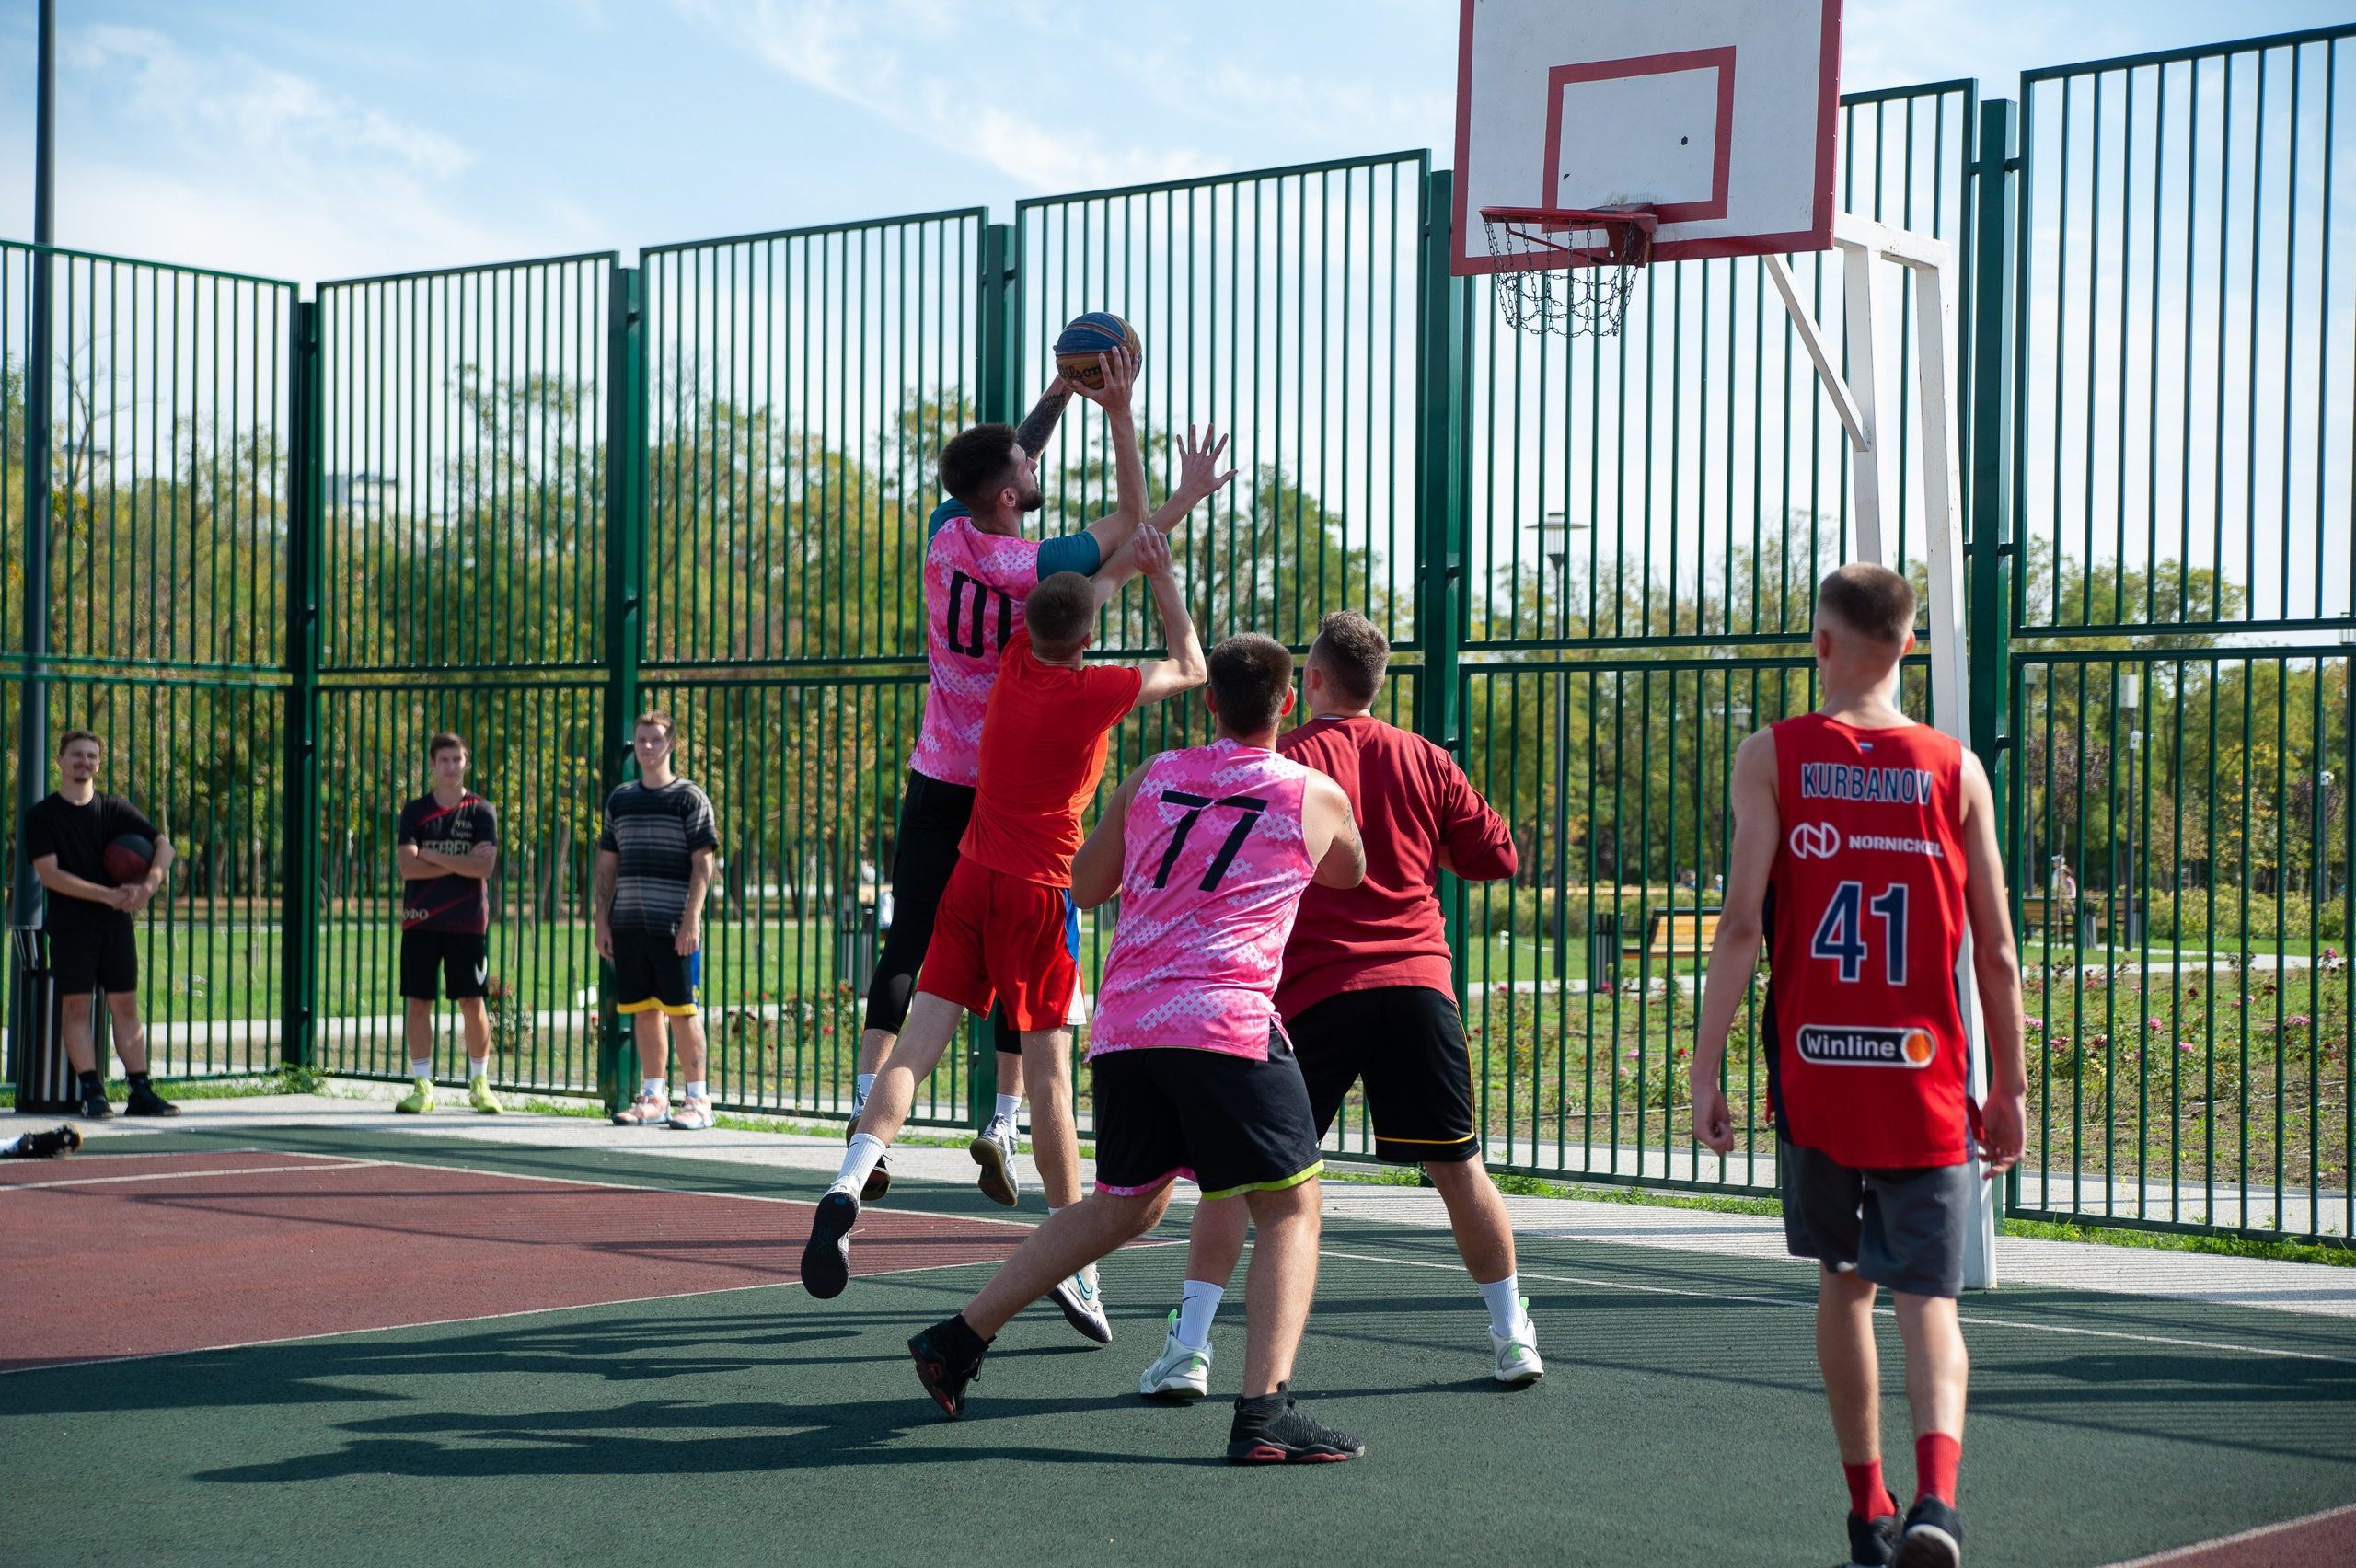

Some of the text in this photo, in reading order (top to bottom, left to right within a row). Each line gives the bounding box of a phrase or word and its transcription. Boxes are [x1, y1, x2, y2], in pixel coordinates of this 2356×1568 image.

[1801, 763, 1933, 806] KURBANOV
[1152, 790, 1269, 893] 77
[1848, 835, 1944, 858] NORNICKEL
[1811, 881, 1909, 986] 41
[1805, 1032, 1896, 1057] Winline
